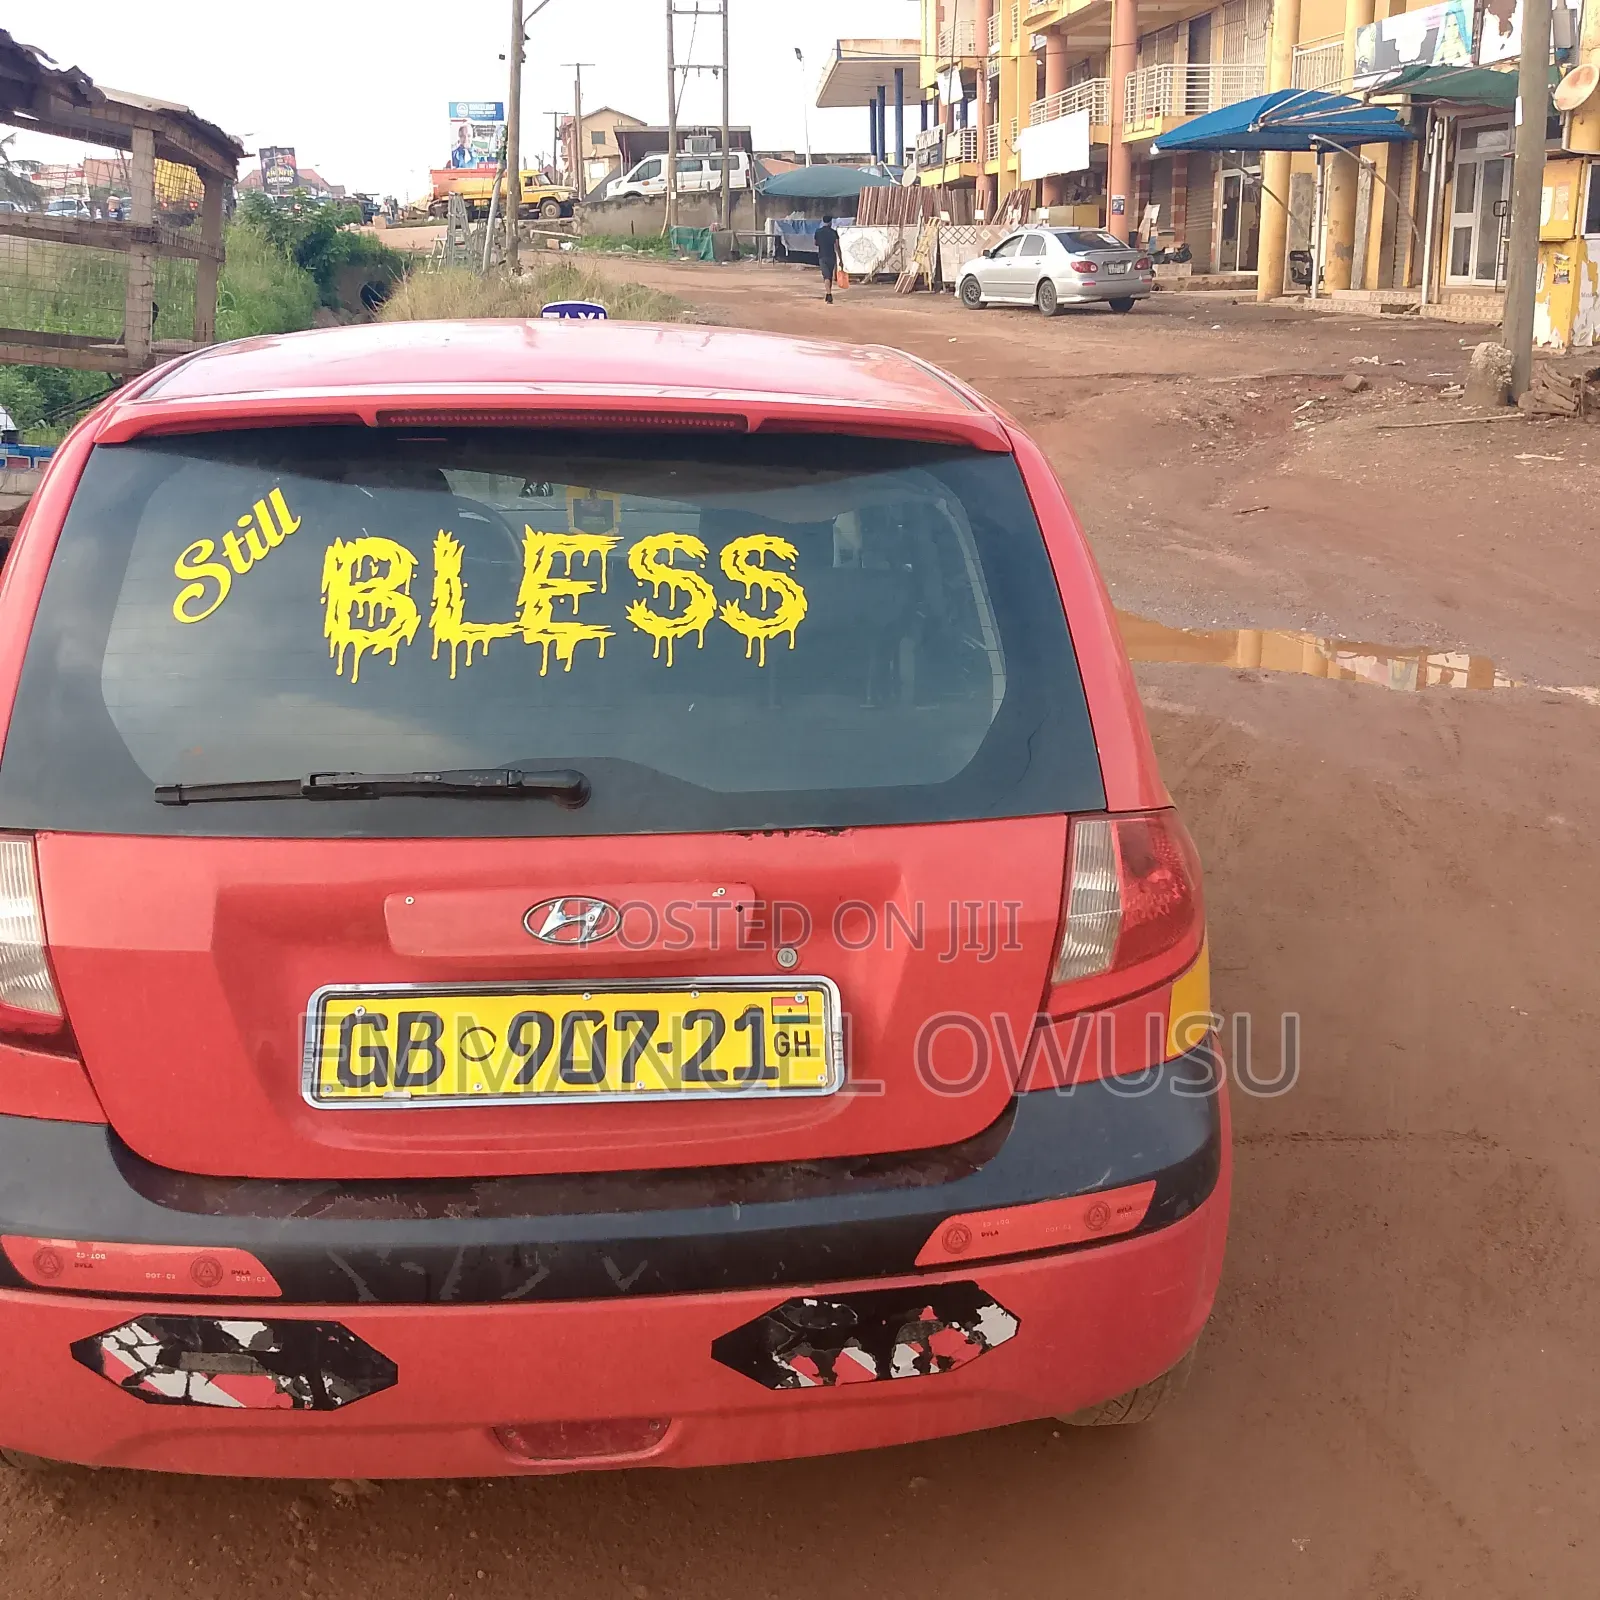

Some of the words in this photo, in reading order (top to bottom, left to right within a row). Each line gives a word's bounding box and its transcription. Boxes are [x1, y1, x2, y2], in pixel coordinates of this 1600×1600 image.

[172, 487, 302, 624] Still
[321, 524, 808, 683] BLESS
[337, 1010, 446, 1088] GB
[507, 1007, 780, 1085] 907-21
[773, 1030, 812, 1058] GH
